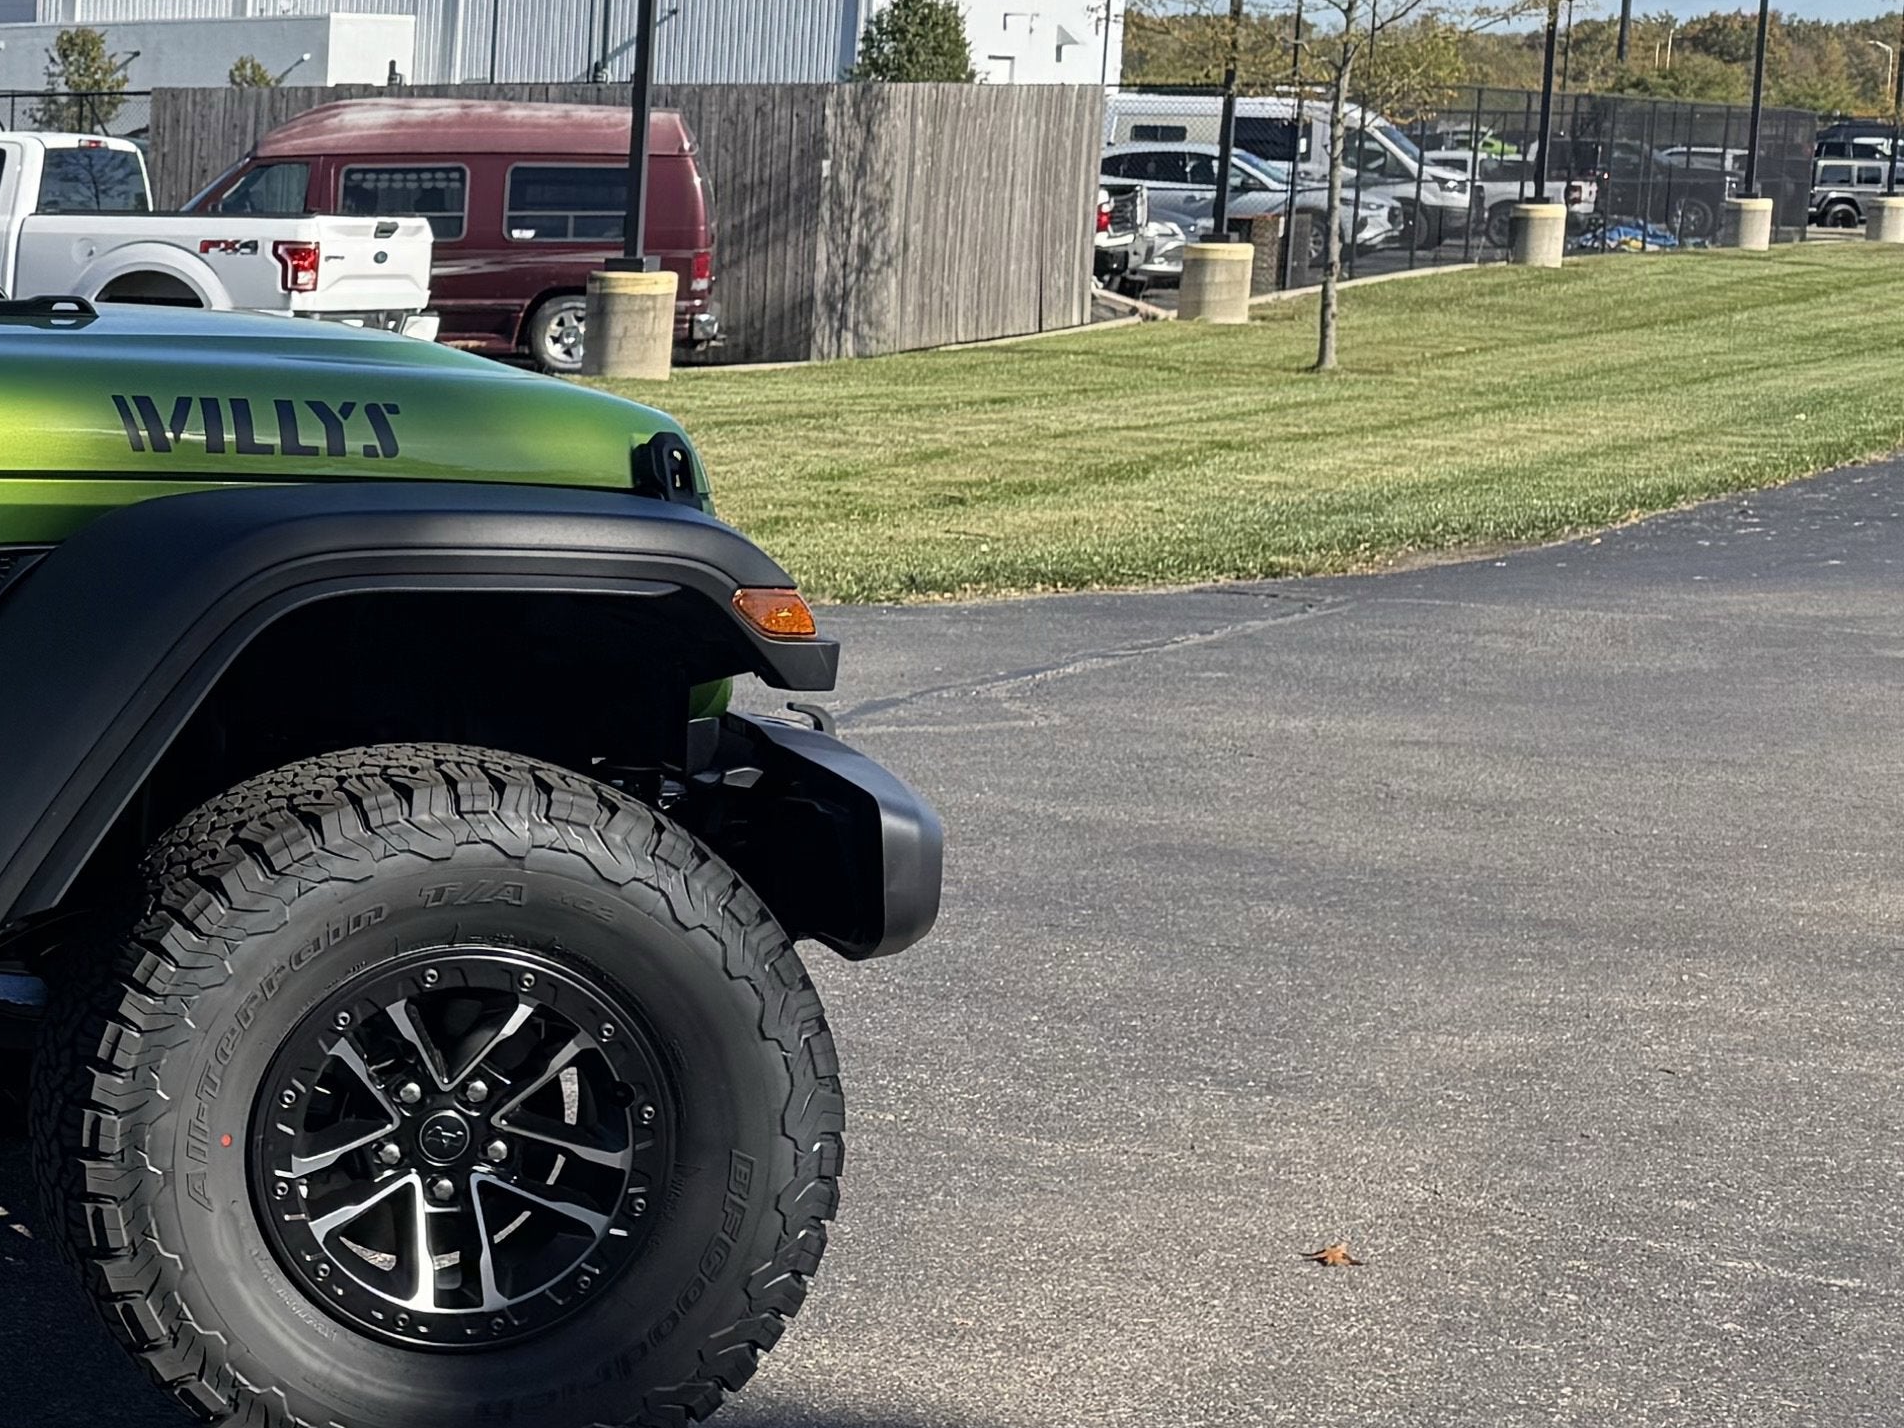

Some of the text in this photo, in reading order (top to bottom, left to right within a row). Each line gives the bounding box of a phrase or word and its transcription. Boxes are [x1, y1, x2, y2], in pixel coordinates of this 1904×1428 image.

[199, 239, 258, 255] FX4
[111, 394, 401, 459] WILLYS
[185, 901, 389, 1212] All-Terrain
[418, 879, 530, 911] T/A
